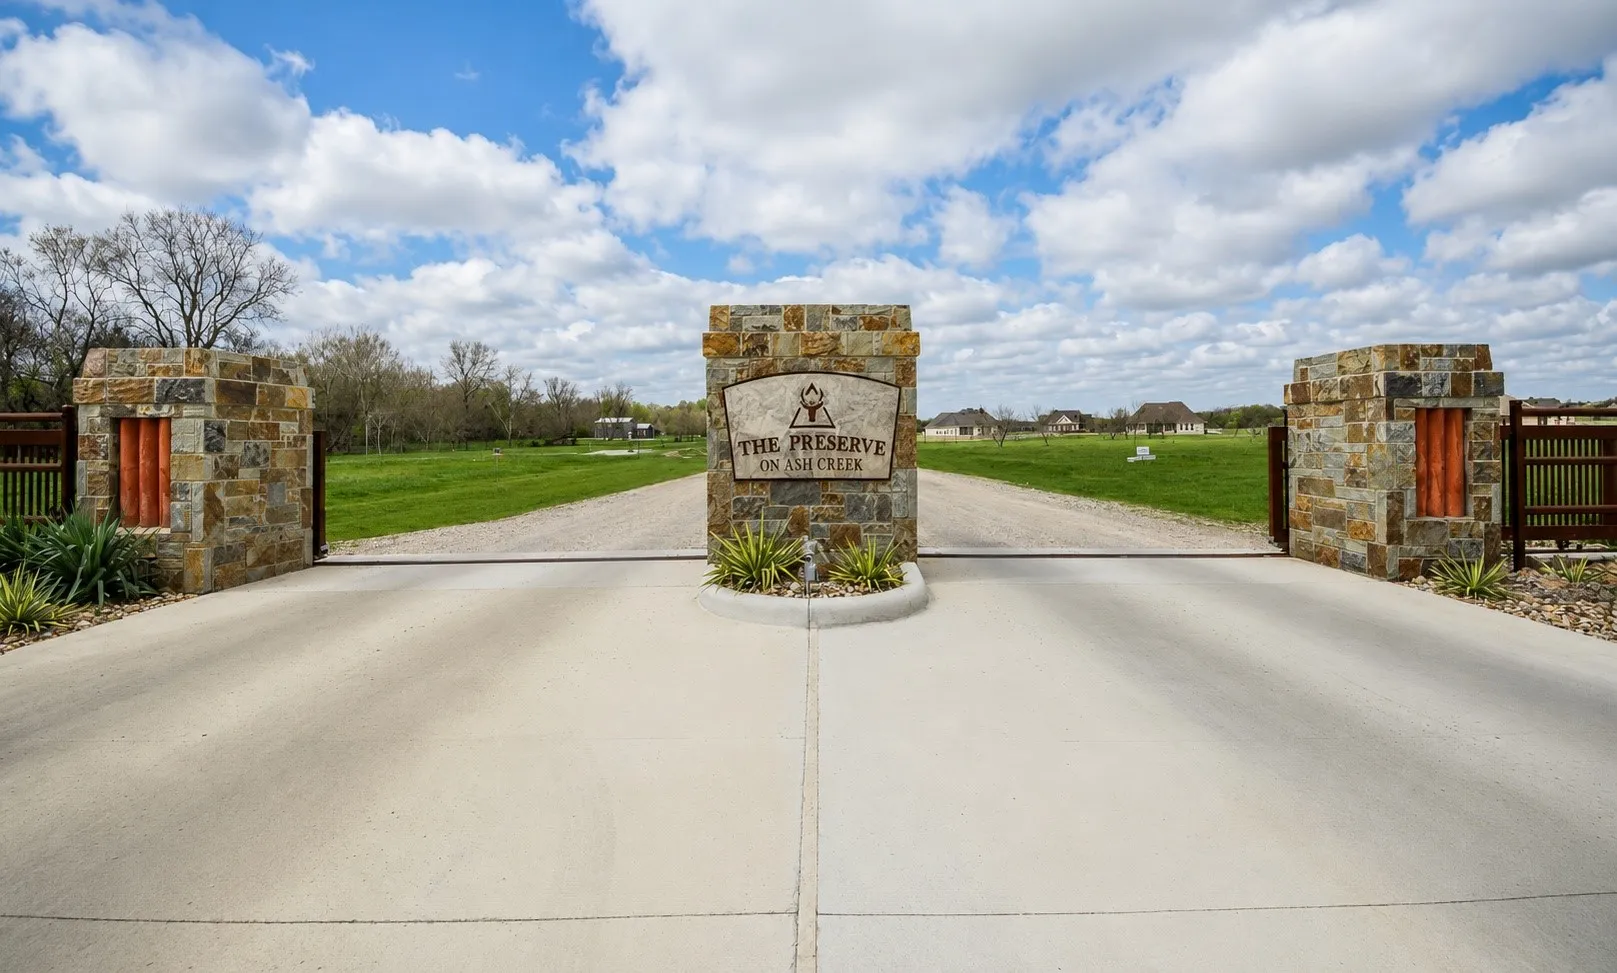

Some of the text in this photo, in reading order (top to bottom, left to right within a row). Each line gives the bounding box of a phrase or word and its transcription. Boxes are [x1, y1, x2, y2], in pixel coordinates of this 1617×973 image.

[738, 434, 886, 456] THE PRESERVE
[760, 458, 863, 471] ON ASH CREEK
